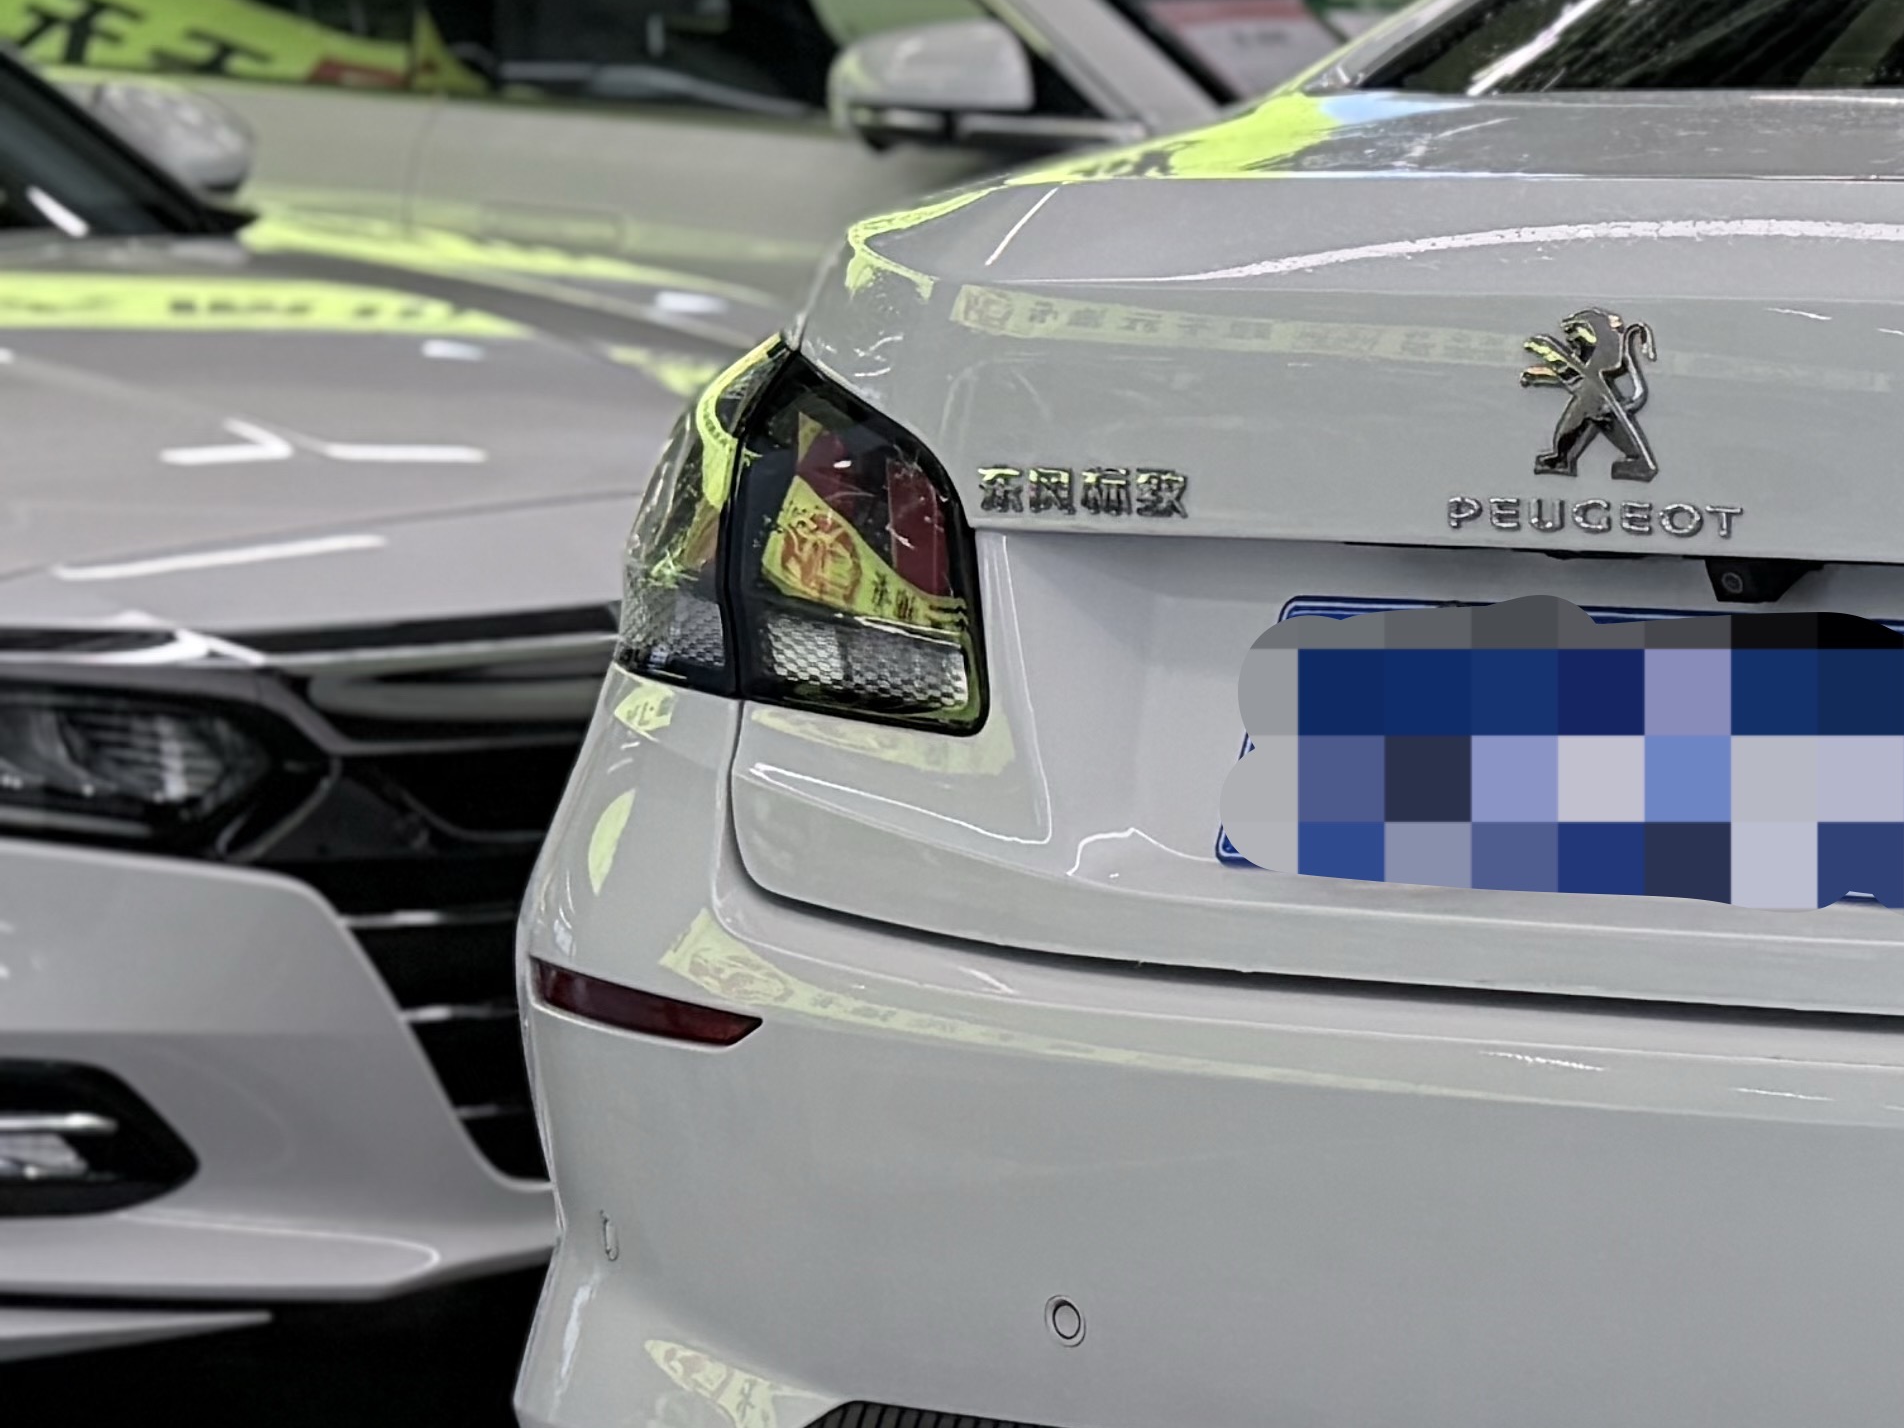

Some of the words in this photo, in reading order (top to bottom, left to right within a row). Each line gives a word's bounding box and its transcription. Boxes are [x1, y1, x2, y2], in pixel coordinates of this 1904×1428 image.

[976, 464, 1190, 520] 东风标致
[1447, 494, 1745, 539] PEUGEOT
